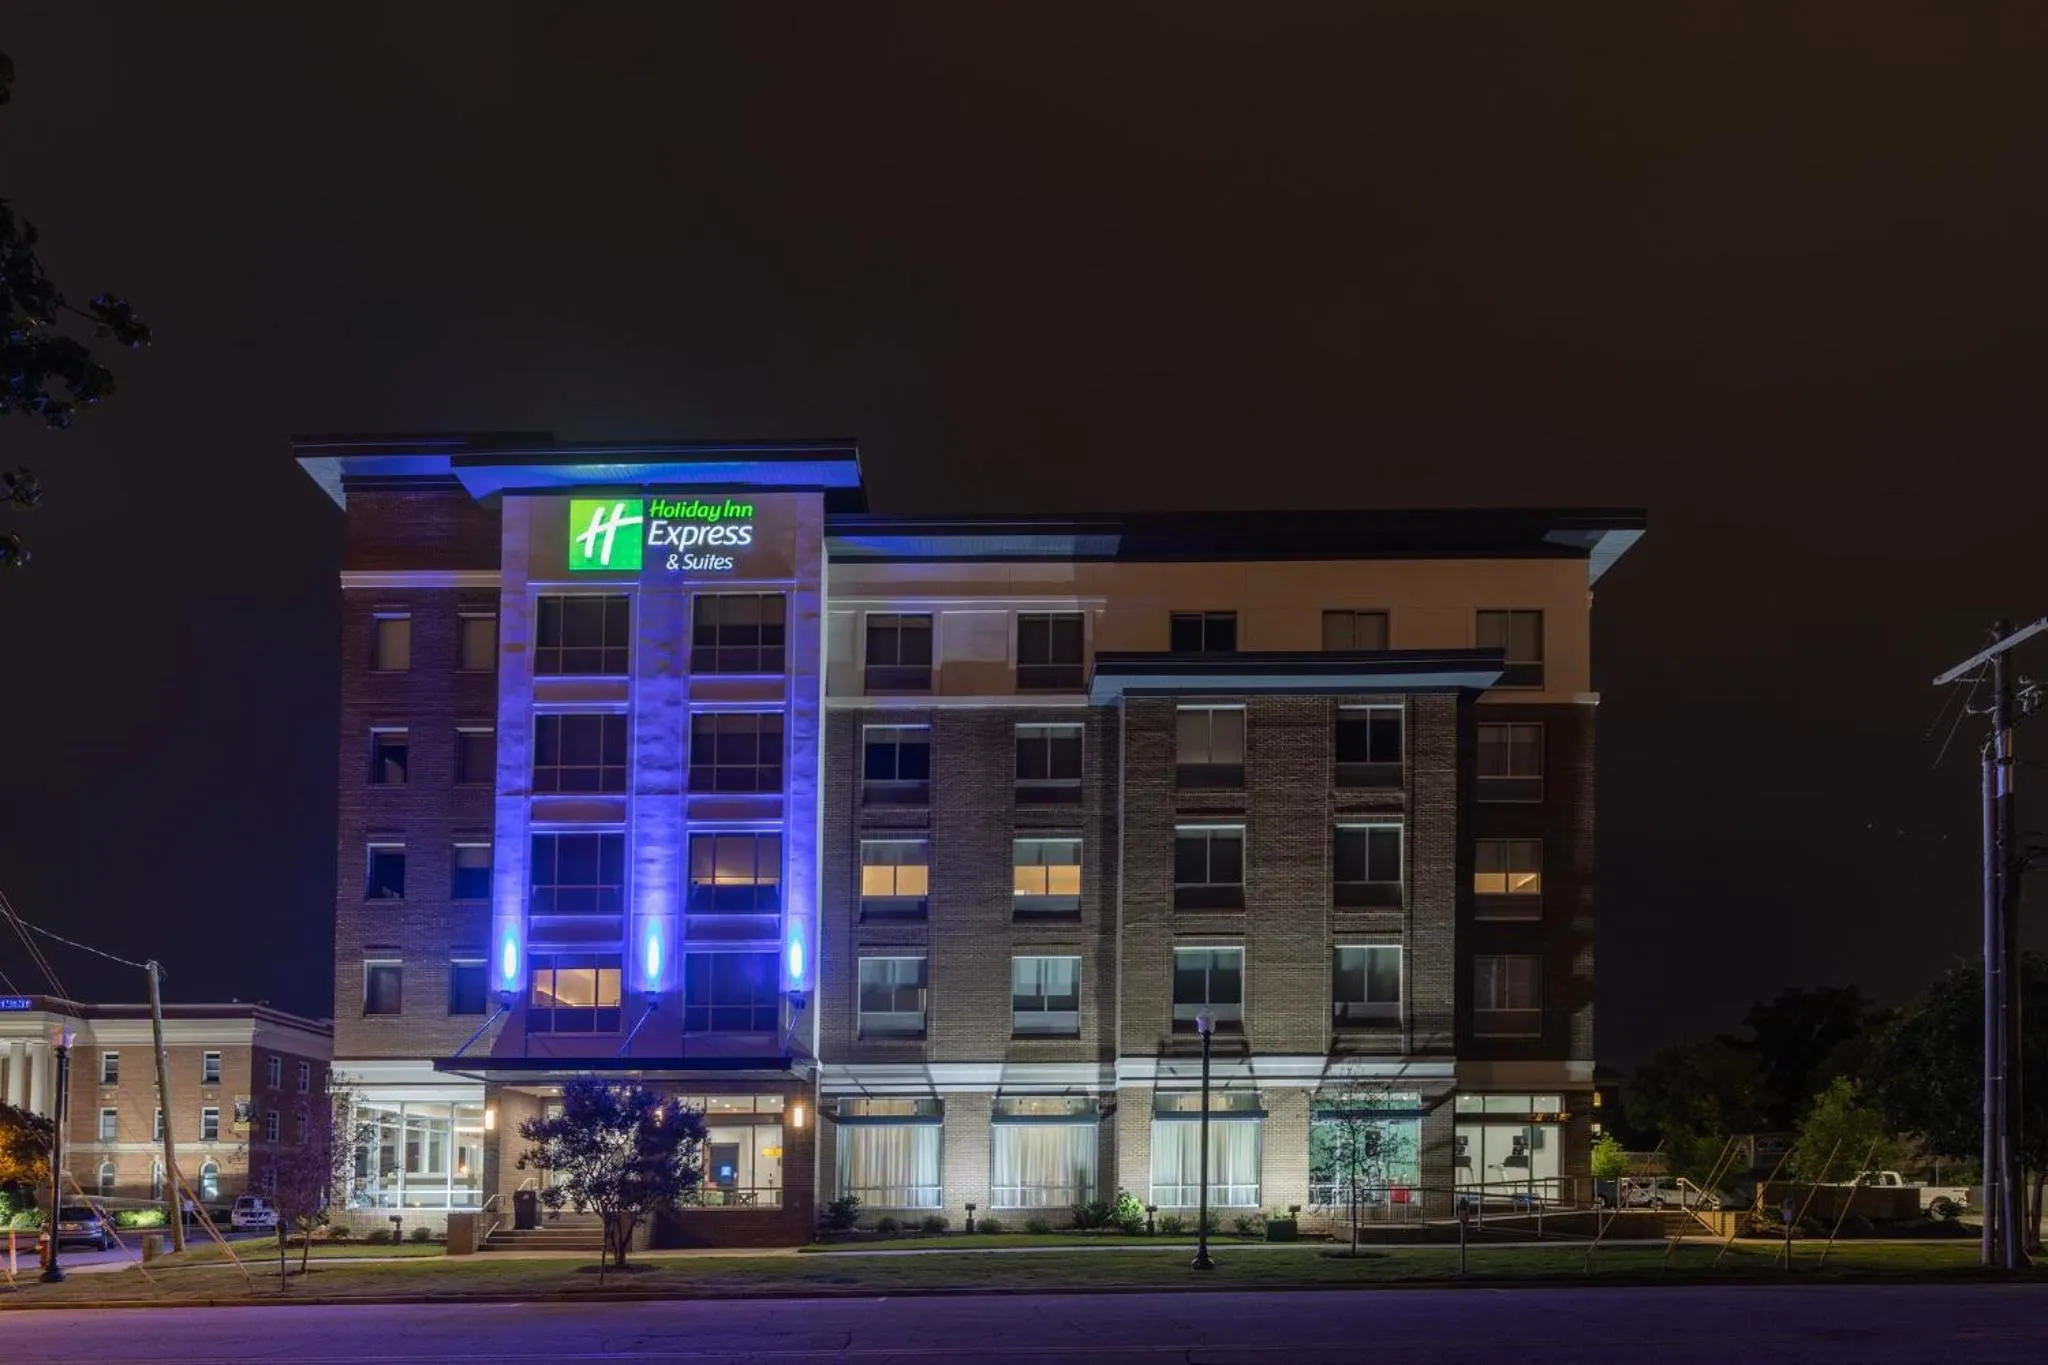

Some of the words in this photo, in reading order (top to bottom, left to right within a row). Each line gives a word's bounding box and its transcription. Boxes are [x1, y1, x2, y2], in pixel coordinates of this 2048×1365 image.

[649, 499, 721, 522] Holiday
[723, 499, 753, 518] Inn
[647, 520, 753, 552] Express
[666, 553, 680, 570] &
[682, 553, 734, 570] Suites
